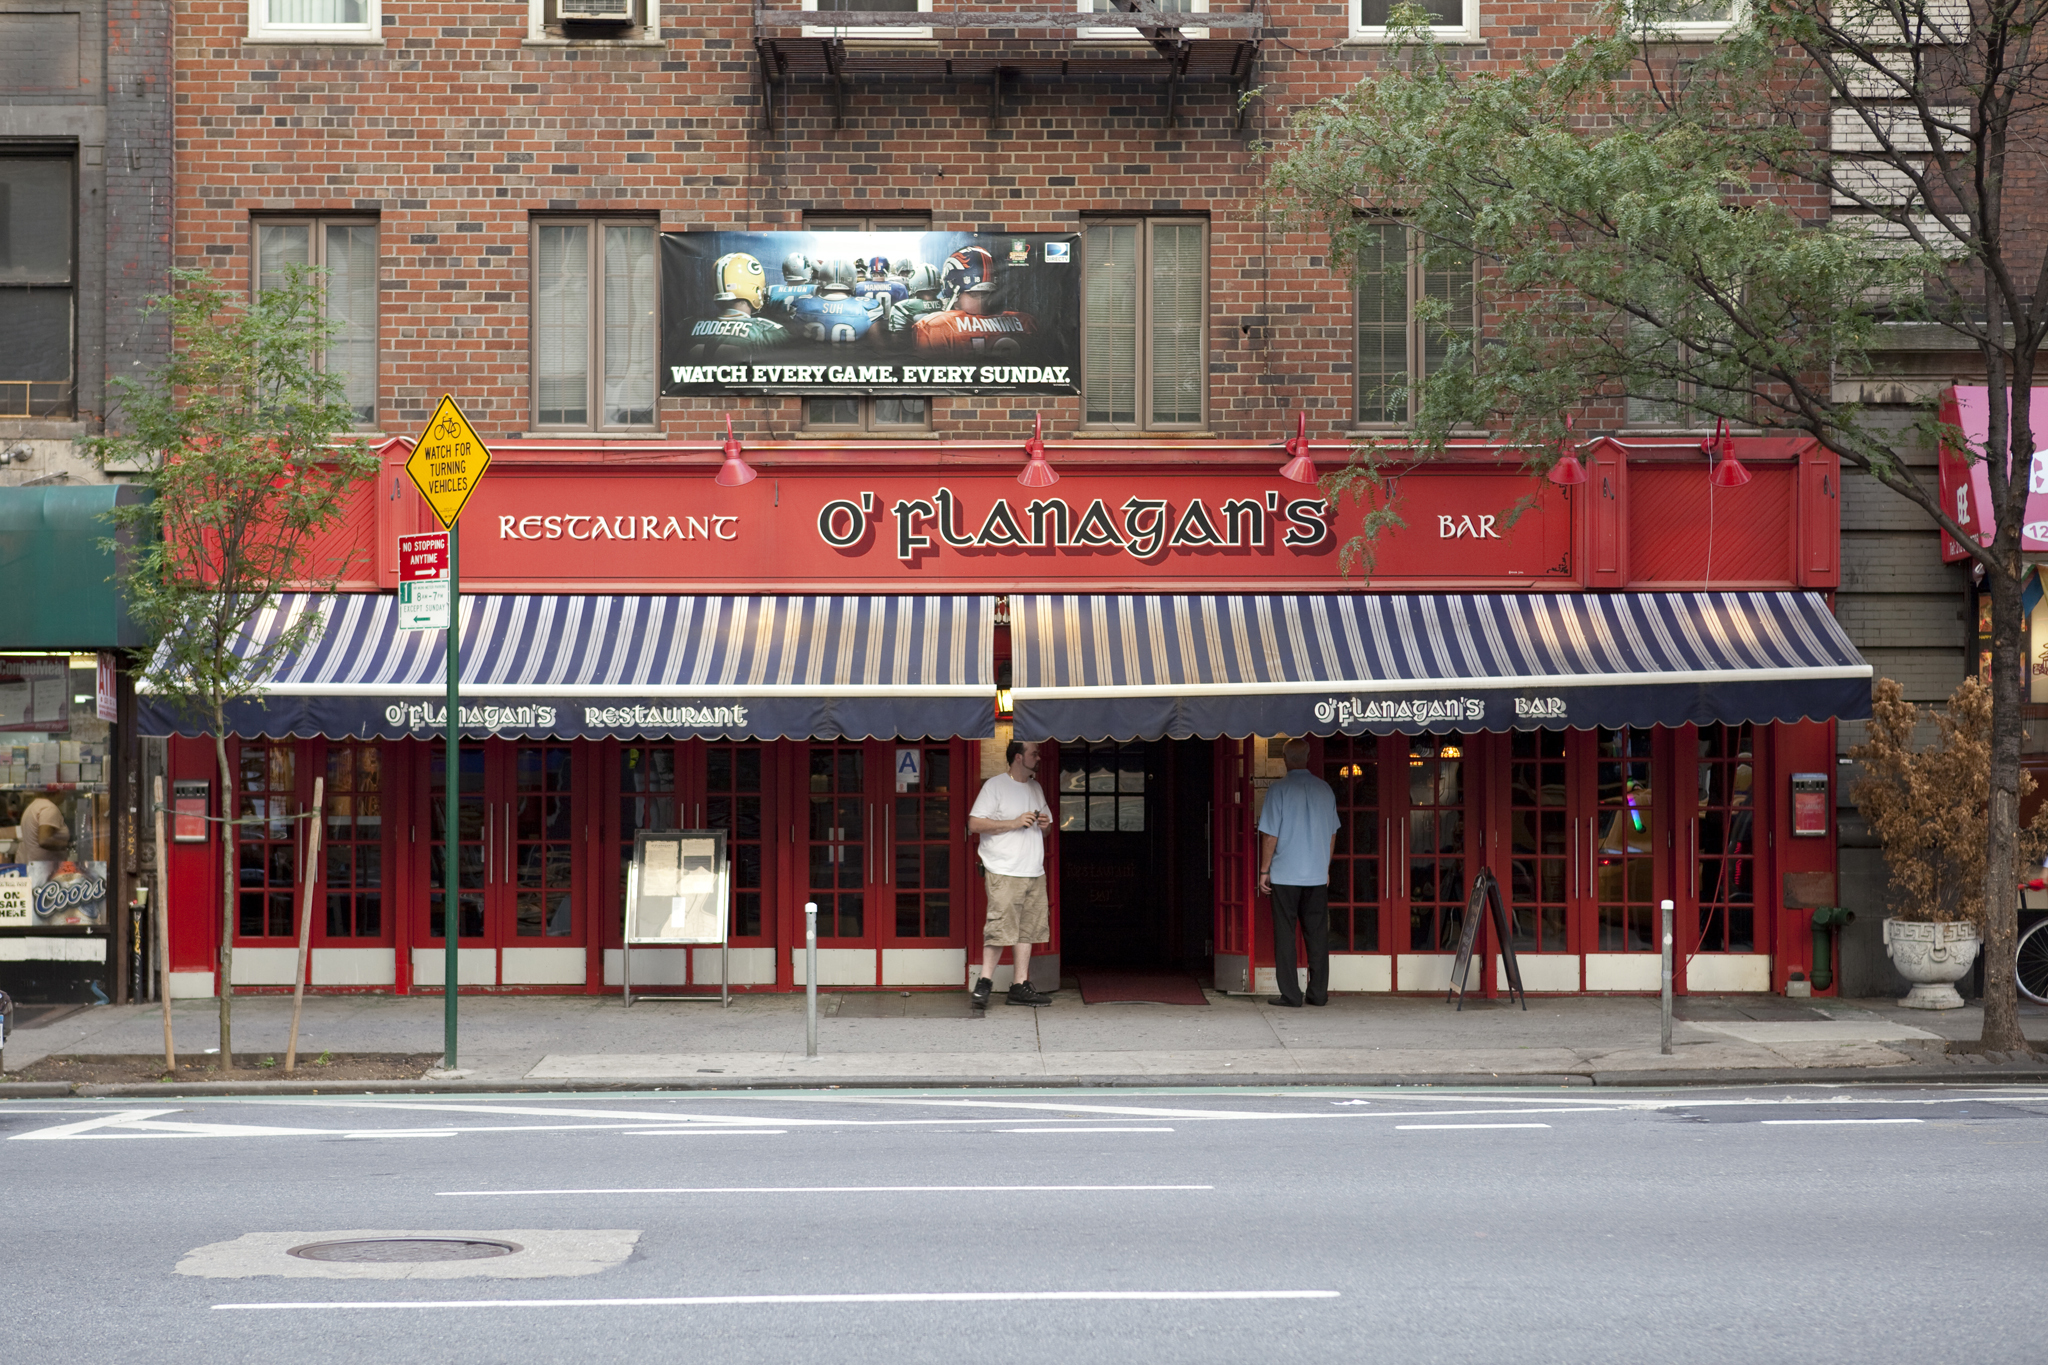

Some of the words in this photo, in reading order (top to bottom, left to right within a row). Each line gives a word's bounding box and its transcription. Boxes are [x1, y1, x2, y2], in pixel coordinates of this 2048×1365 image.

[777, 285, 808, 293] NEWTON
[864, 283, 892, 291] MANNING
[822, 302, 844, 315] SUH
[922, 300, 941, 309] REVIS
[691, 320, 753, 338] RODGERS
[955, 316, 1024, 333] MANNING
[670, 365, 748, 383] WATCH
[752, 365, 827, 383] EVERY
[828, 365, 899, 383] GAME.
[902, 366, 977, 383] EVERY
[979, 366, 1071, 384] SUNDAY.
[424, 444, 452, 460] WATCH
[455, 442, 471, 457] FOR
[430, 460, 466, 477] TURNING
[429, 477, 468, 494] VEHICLES
[498, 514, 739, 541] RESTAURANT
[1438, 514, 1501, 539] BAR
[402, 541, 413, 553] NO
[414, 539, 445, 551] STOPPING
[410, 553, 438, 565] ANYTIME
[403, 604, 423, 613] EXCEPT
[425, 603, 445, 612] SUNDAY
[585, 704, 747, 728] RESTAURANT
[1514, 697, 1566, 718] BAR
[898, 751, 918, 774] A
[3, 891, 21, 900] ON
[33, 877, 107, 916] Coors
